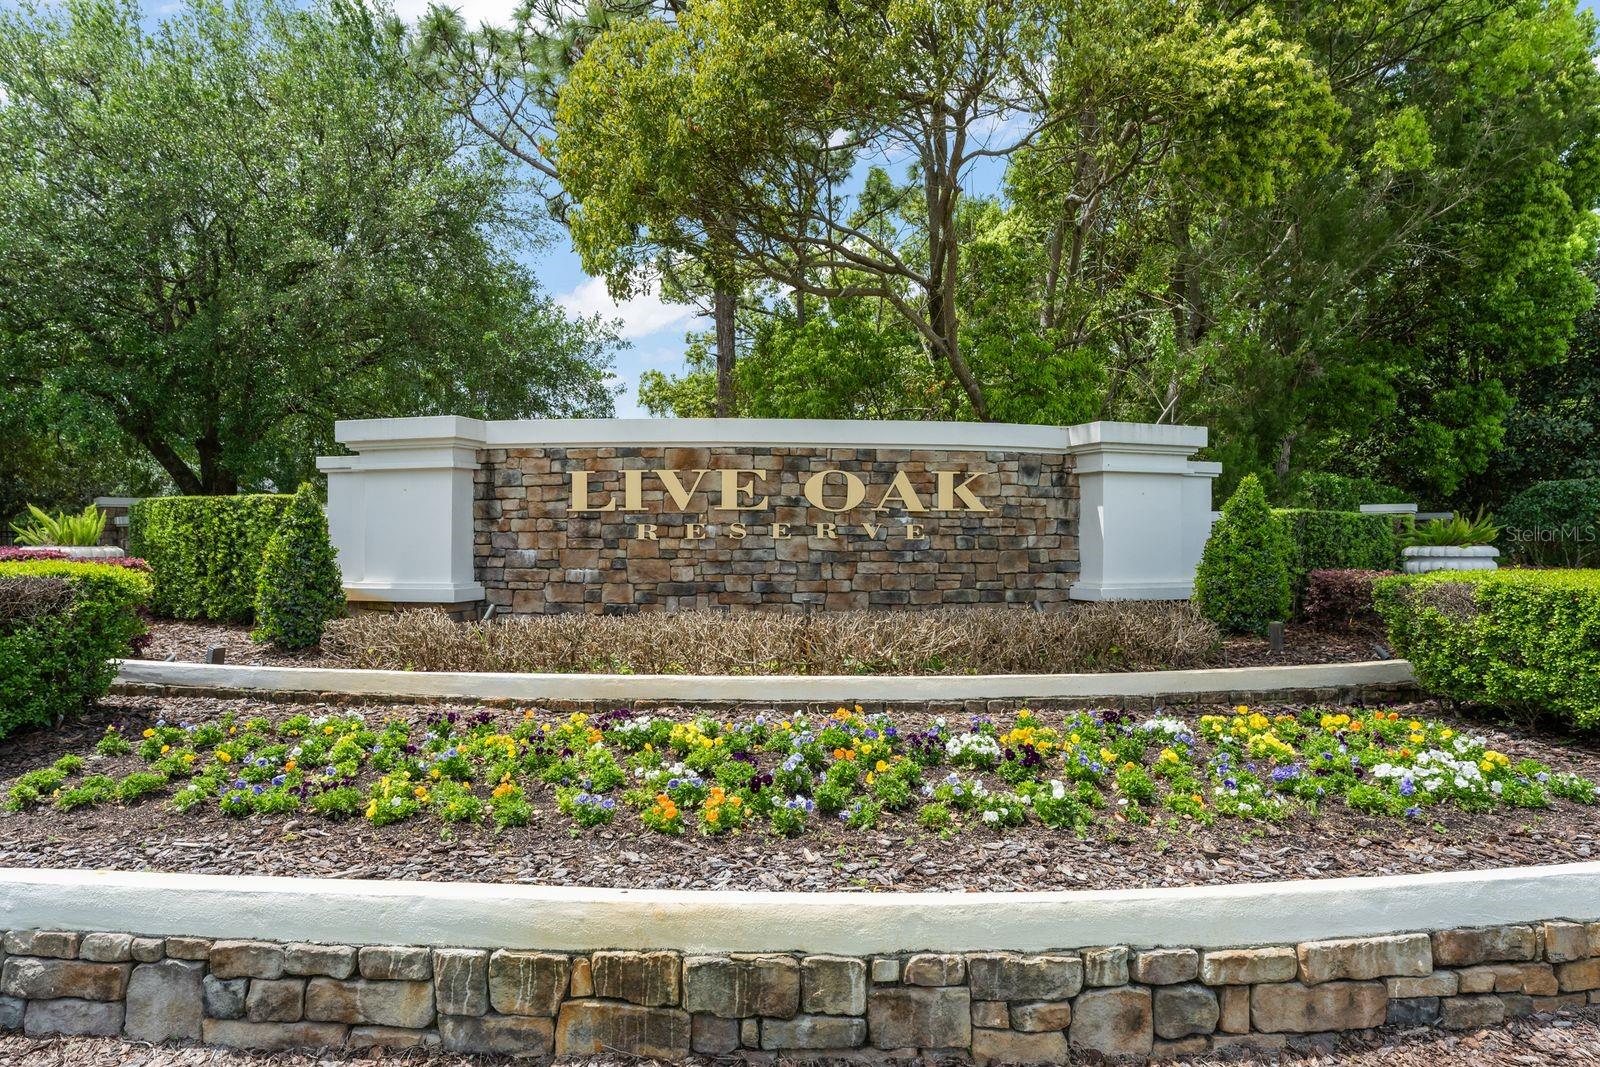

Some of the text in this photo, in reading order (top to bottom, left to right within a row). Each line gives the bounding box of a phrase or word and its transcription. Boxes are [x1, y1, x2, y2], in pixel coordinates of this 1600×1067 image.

[566, 469, 994, 512] LIVE OAK
[635, 522, 926, 541] RESERVE
